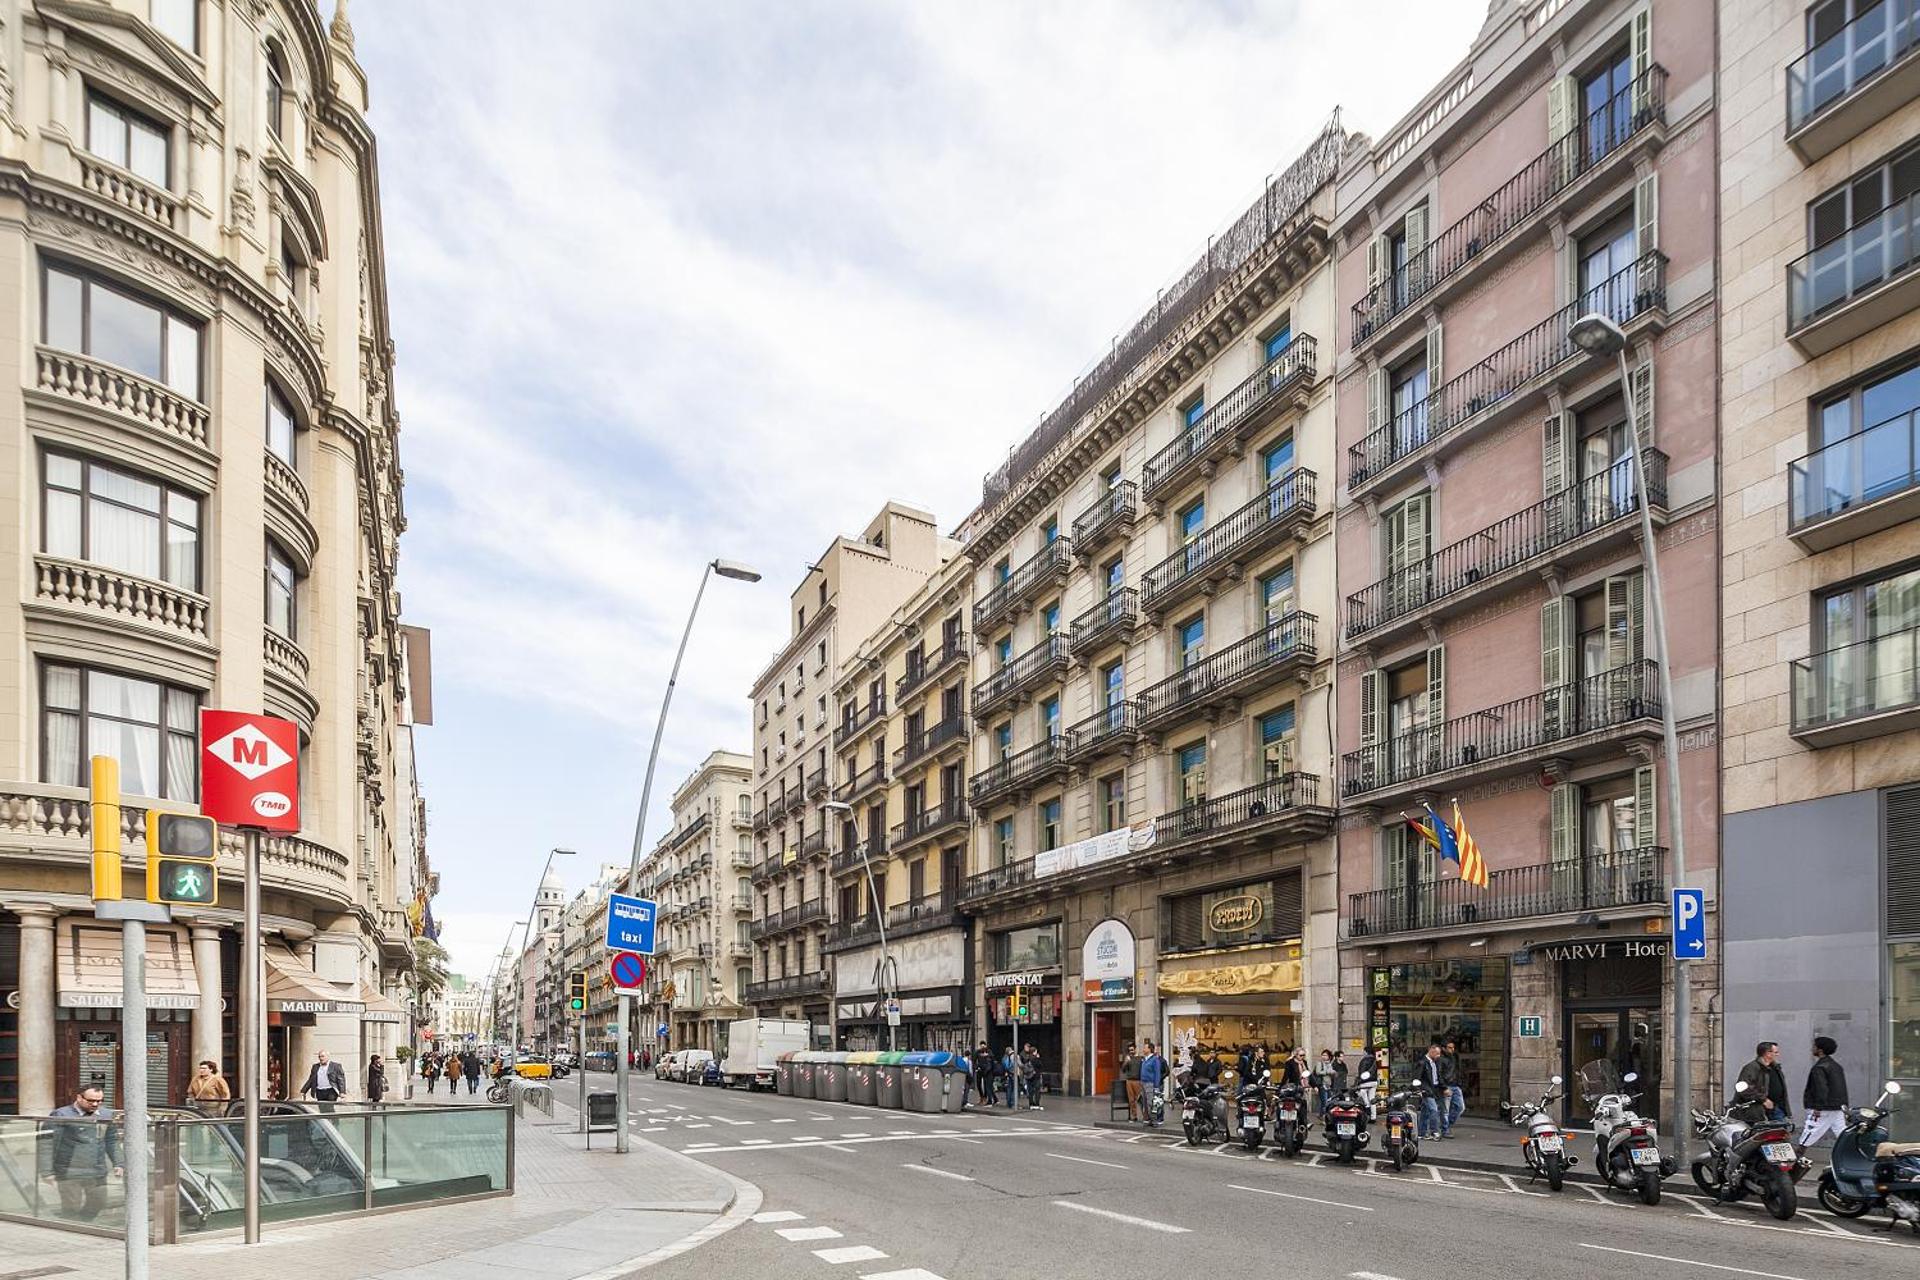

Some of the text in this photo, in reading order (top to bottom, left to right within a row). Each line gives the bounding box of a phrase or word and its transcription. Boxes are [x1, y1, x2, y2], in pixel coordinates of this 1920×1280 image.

[233, 737, 267, 766] M
[261, 800, 286, 810] TMB
[714, 796, 722, 969] HOTEL INGLATERRA
[1679, 894, 1698, 931] P
[621, 931, 642, 944] taxi
[1545, 943, 1606, 962] MARVI
[70, 995, 113, 1006] SALON
[282, 1001, 329, 1012] MARNI
[1525, 1019, 1535, 1031] H
